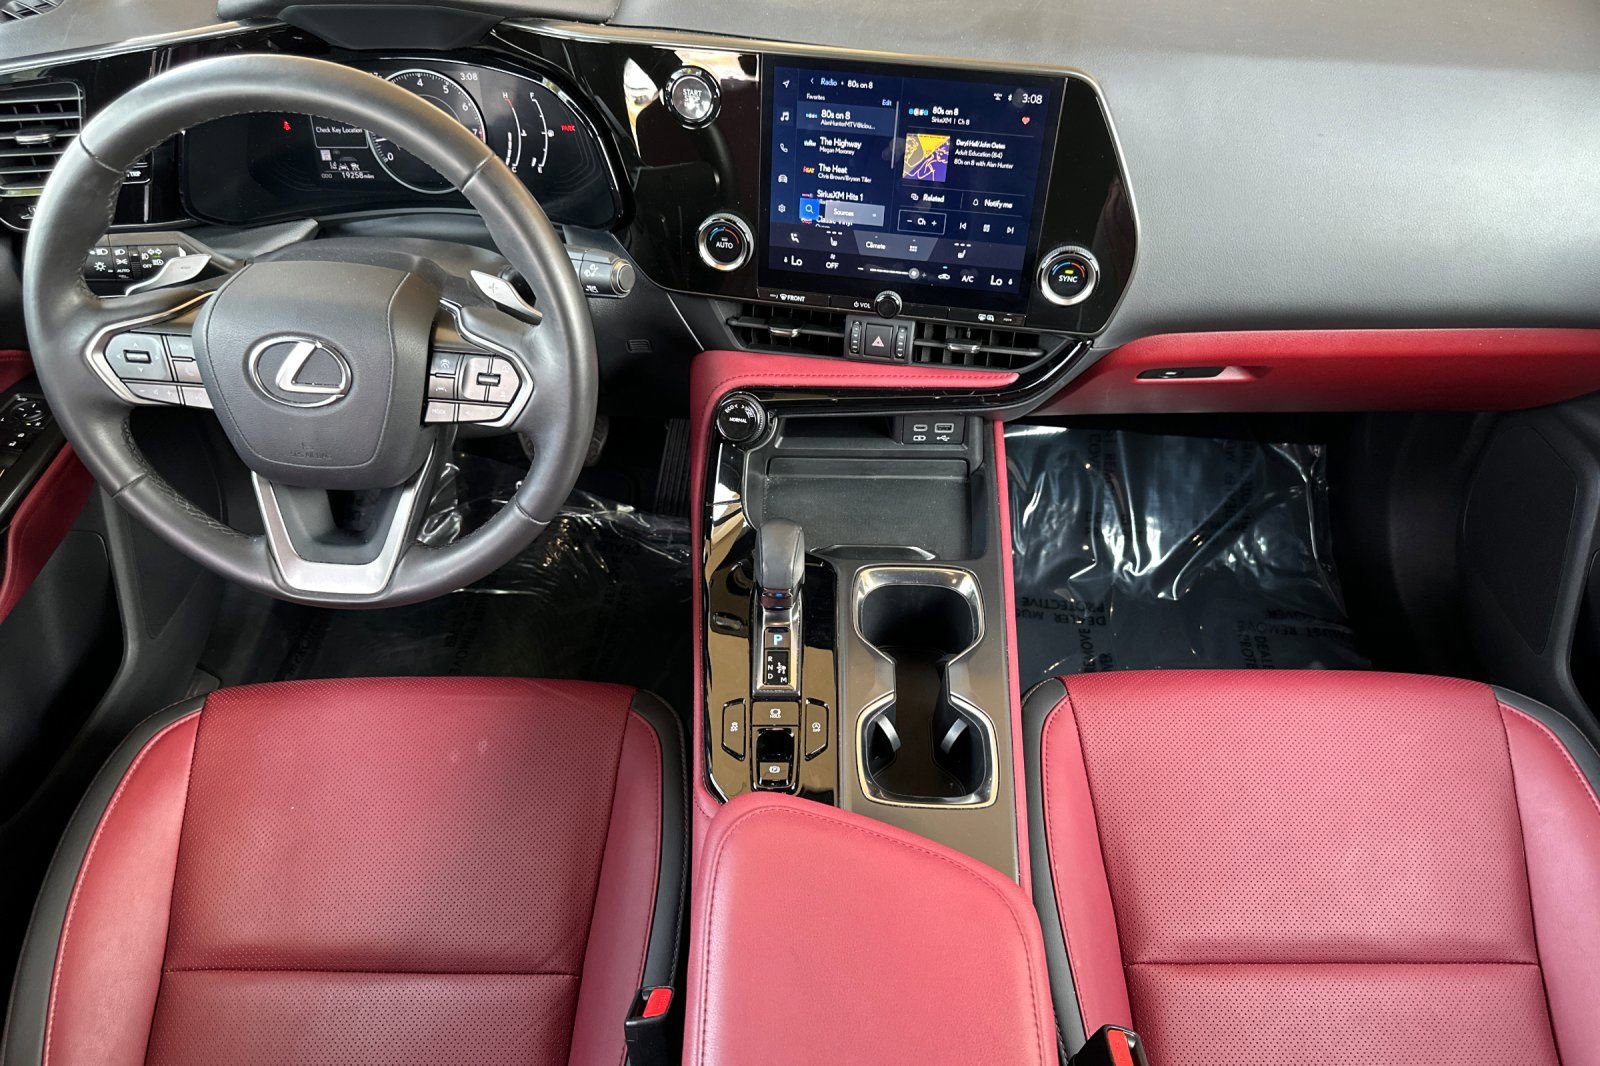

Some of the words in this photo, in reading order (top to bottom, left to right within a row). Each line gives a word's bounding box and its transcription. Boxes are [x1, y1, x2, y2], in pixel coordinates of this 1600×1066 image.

[460, 72, 478, 80] 3:08
[416, 78, 424, 86] 4
[820, 77, 838, 86] Radio
[847, 80, 859, 88] 80s
[442, 85, 449, 94] 5
[806, 92, 826, 101] Favorites
[1022, 93, 1043, 104] 3:08
[462, 102, 469, 111] 6
[932, 106, 945, 115] 80s
[954, 108, 959, 116] 8
[821, 109, 834, 118] 80s
[845, 111, 851, 120] 8
[820, 136, 833, 146] The
[833, 137, 862, 150] Highway
[387, 152, 394, 161] 0
[818, 163, 831, 172] The
[832, 164, 848, 174] Heat
[817, 189, 845, 199] SiriusXM
[846, 192, 858, 201] Hits
[922, 193, 945, 203] Related
[984, 199, 1002, 209] Notify
[833, 208, 854, 217] Sources
[716, 241, 734, 249] AUTO
[865, 241, 886, 250] Climate
[791, 255, 803, 266] Lo
[990, 274, 1003, 286] Lo
[1058, 274, 1078, 283] SYNC
[773, 634, 783, 646] P
